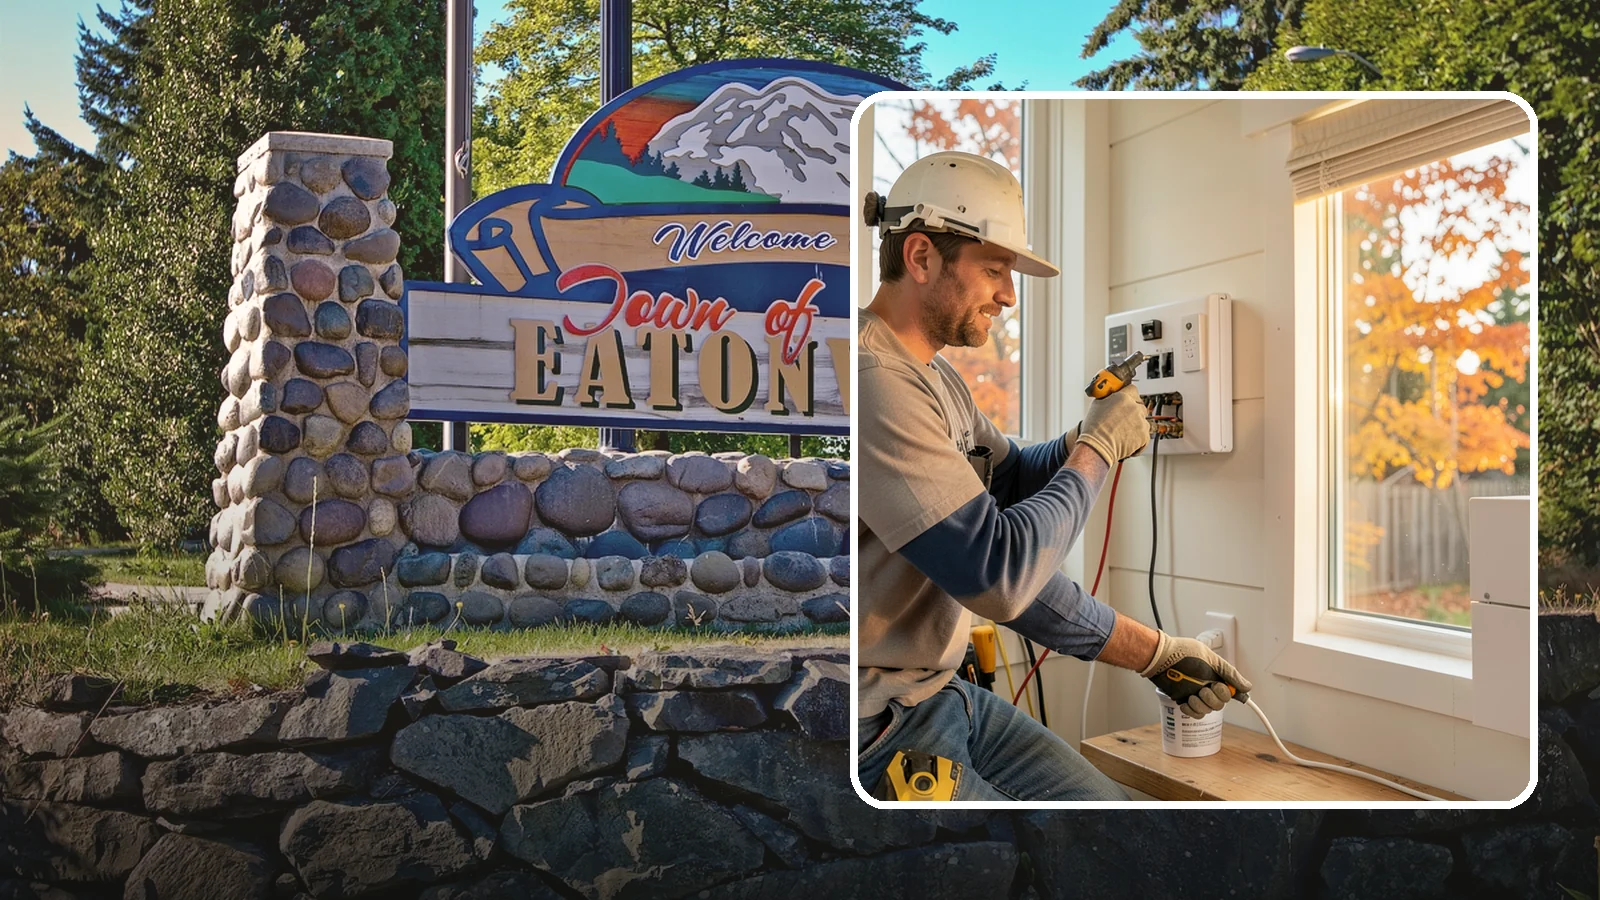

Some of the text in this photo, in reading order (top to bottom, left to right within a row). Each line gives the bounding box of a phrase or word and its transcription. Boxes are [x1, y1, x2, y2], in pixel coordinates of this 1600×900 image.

[653, 220, 837, 263] Welcome
[556, 264, 825, 365] Town of
